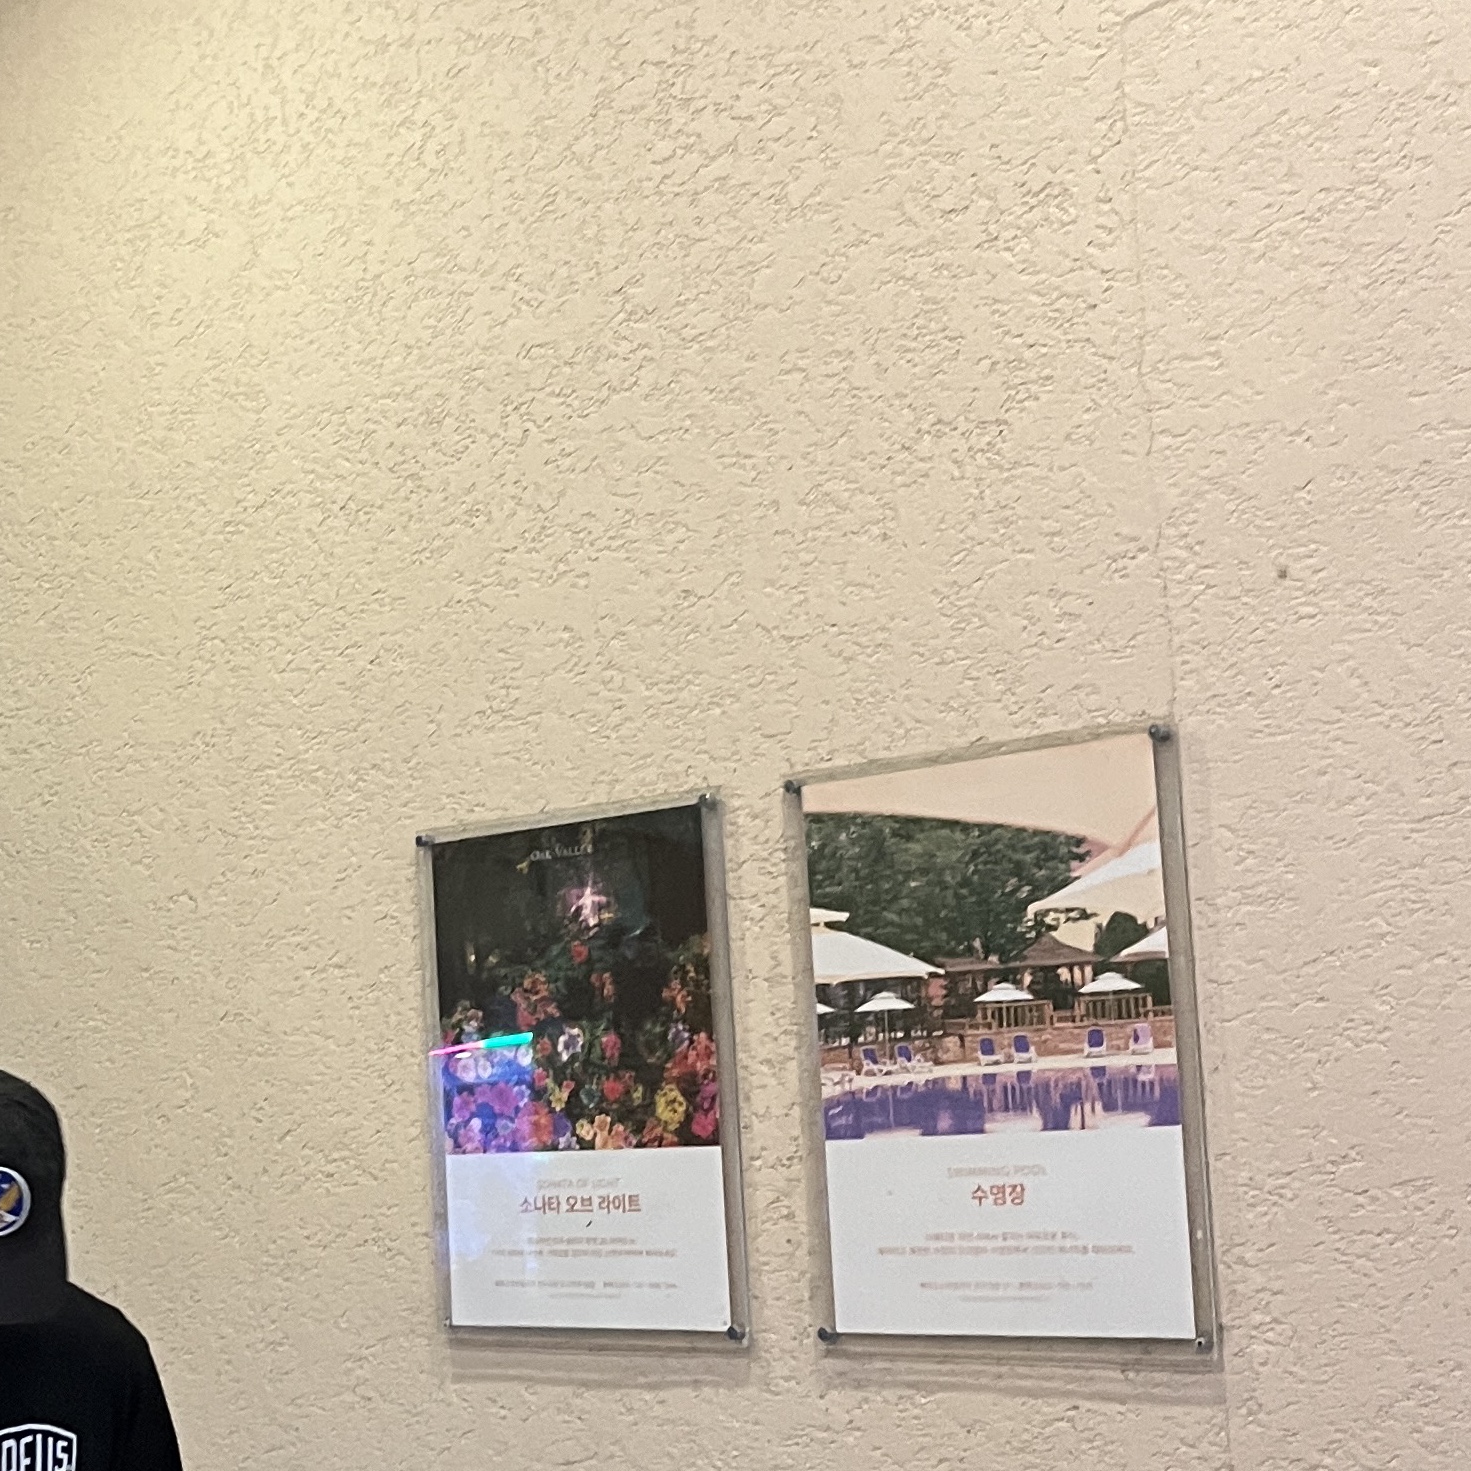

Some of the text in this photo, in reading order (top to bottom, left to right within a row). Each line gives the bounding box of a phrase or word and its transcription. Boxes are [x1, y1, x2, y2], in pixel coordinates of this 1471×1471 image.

[519, 1193, 641, 1214] 소나타 오브 라이트
